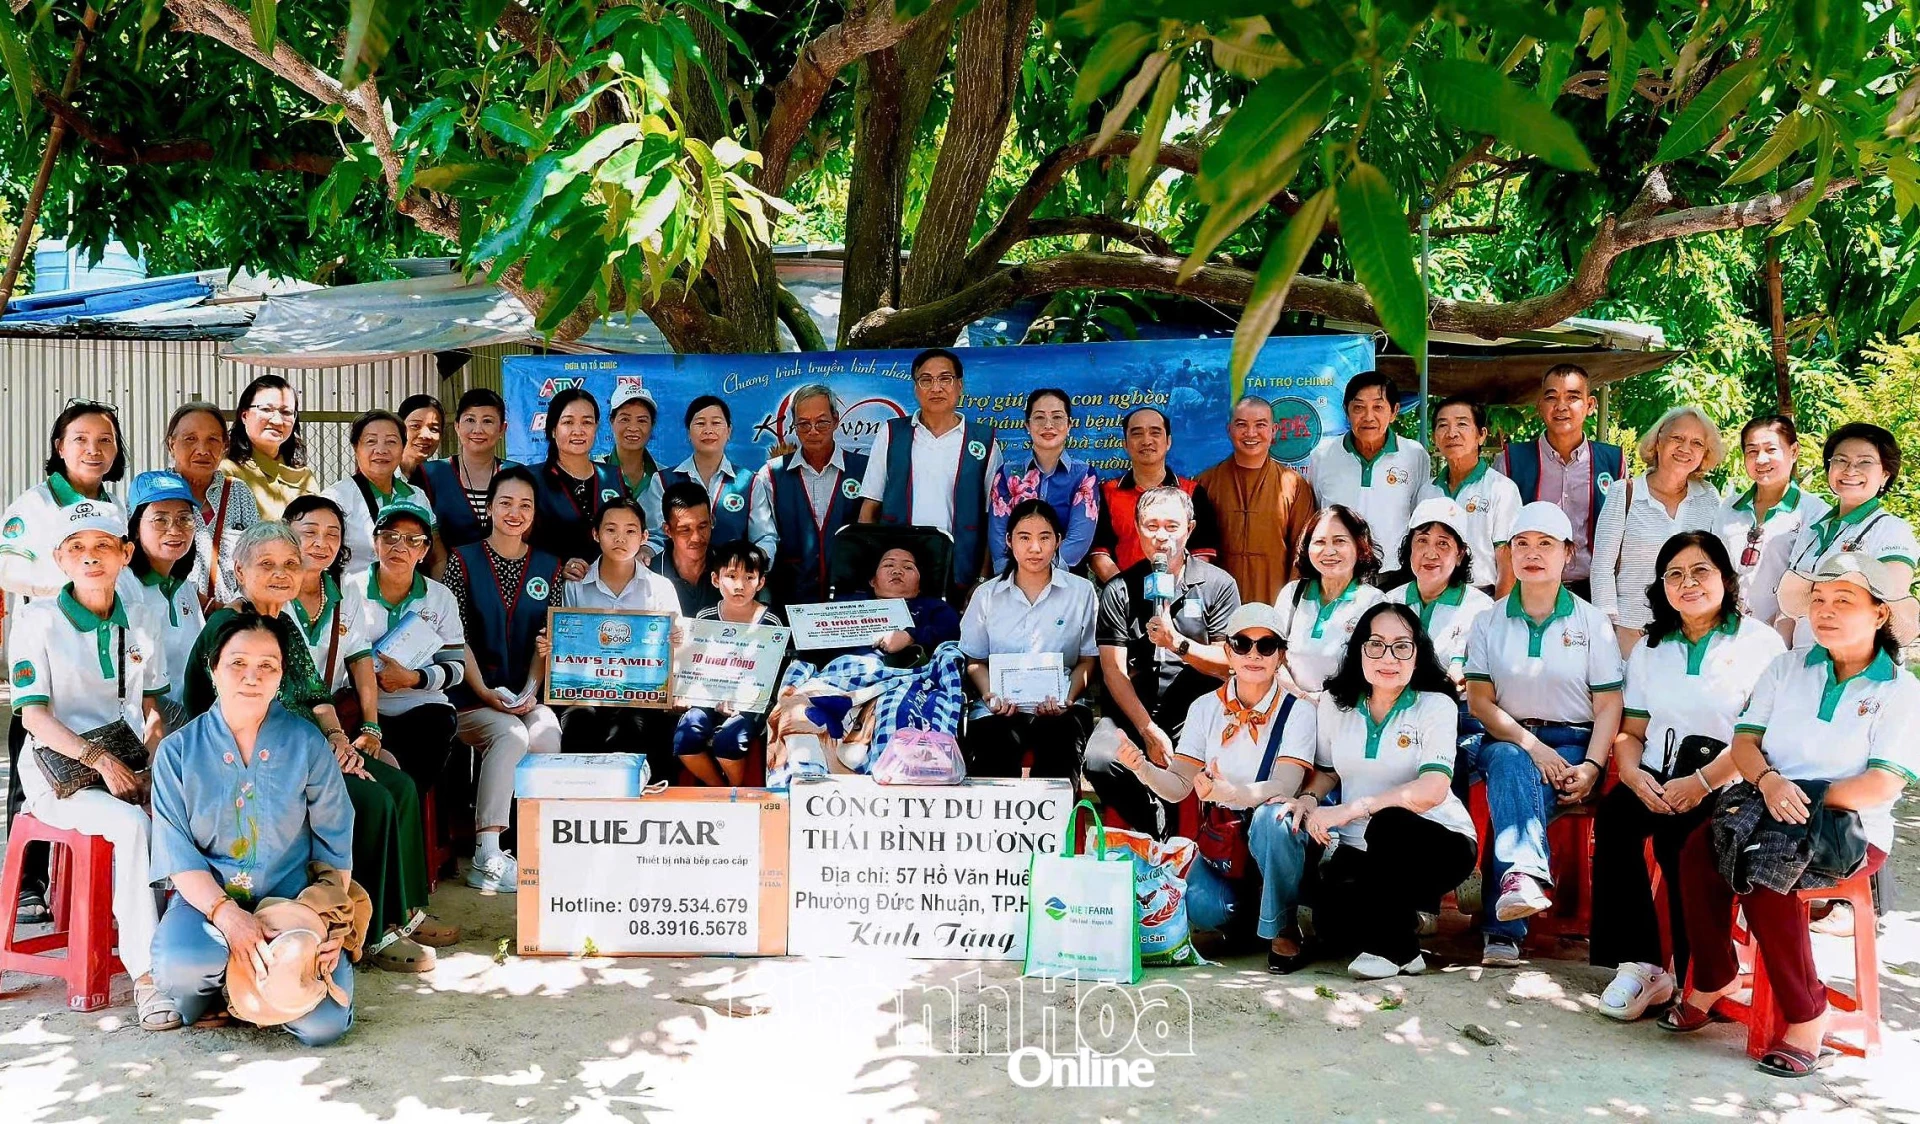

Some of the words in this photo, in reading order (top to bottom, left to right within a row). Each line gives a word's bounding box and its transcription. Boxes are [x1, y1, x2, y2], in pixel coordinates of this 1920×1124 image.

[723, 372, 769, 394] Chương
[775, 358, 801, 378] trình
[808, 359, 845, 377] truyền
[851, 357, 877, 373] hình
[1247, 374, 1265, 387] TÀI
[1270, 374, 1293, 389] TRỢ
[956, 393, 991, 411] Trợ
[1071, 394, 1103, 406] con
[1108, 389, 1170, 410] nghèo:
[840, 421, 881, 441] vọn
[608, 657, 665, 667] FAMILY
[692, 653, 703, 663] 10
[806, 790, 889, 818] CÔNG
[898, 798, 935, 818] TY
[945, 798, 983, 820] DU
[994, 799, 1056, 826] HỌC
[552, 819, 720, 846] BLUESTAR
[802, 824, 869, 850] THÁI
[880, 825, 946, 852] BÌNH
[637, 855, 660, 866] Thiết
[663, 855, 671, 868] bị
[673, 855, 691, 866] nhà
[693, 855, 710, 868] bếp
[712, 858, 729, 866] cao
[732, 855, 749, 868] cấp
[821, 866, 850, 887] Địa
[857, 866, 889, 882] chỉ:
[896, 868, 917, 884] 57
[923, 863, 947, 885] Hồ
[957, 868, 988, 885] Văn
[551, 896, 622, 913] Hotline:
[629, 898, 748, 913] 0979.534.679
[796, 892, 870, 914] Phường
[877, 893, 914, 911] Đức
[921, 893, 985, 915] Nhuận,
[992, 895, 1030, 912] TP.H
[629, 921, 747, 936] 08.3916.5678
[933, 922, 1018, 954] Tặng
